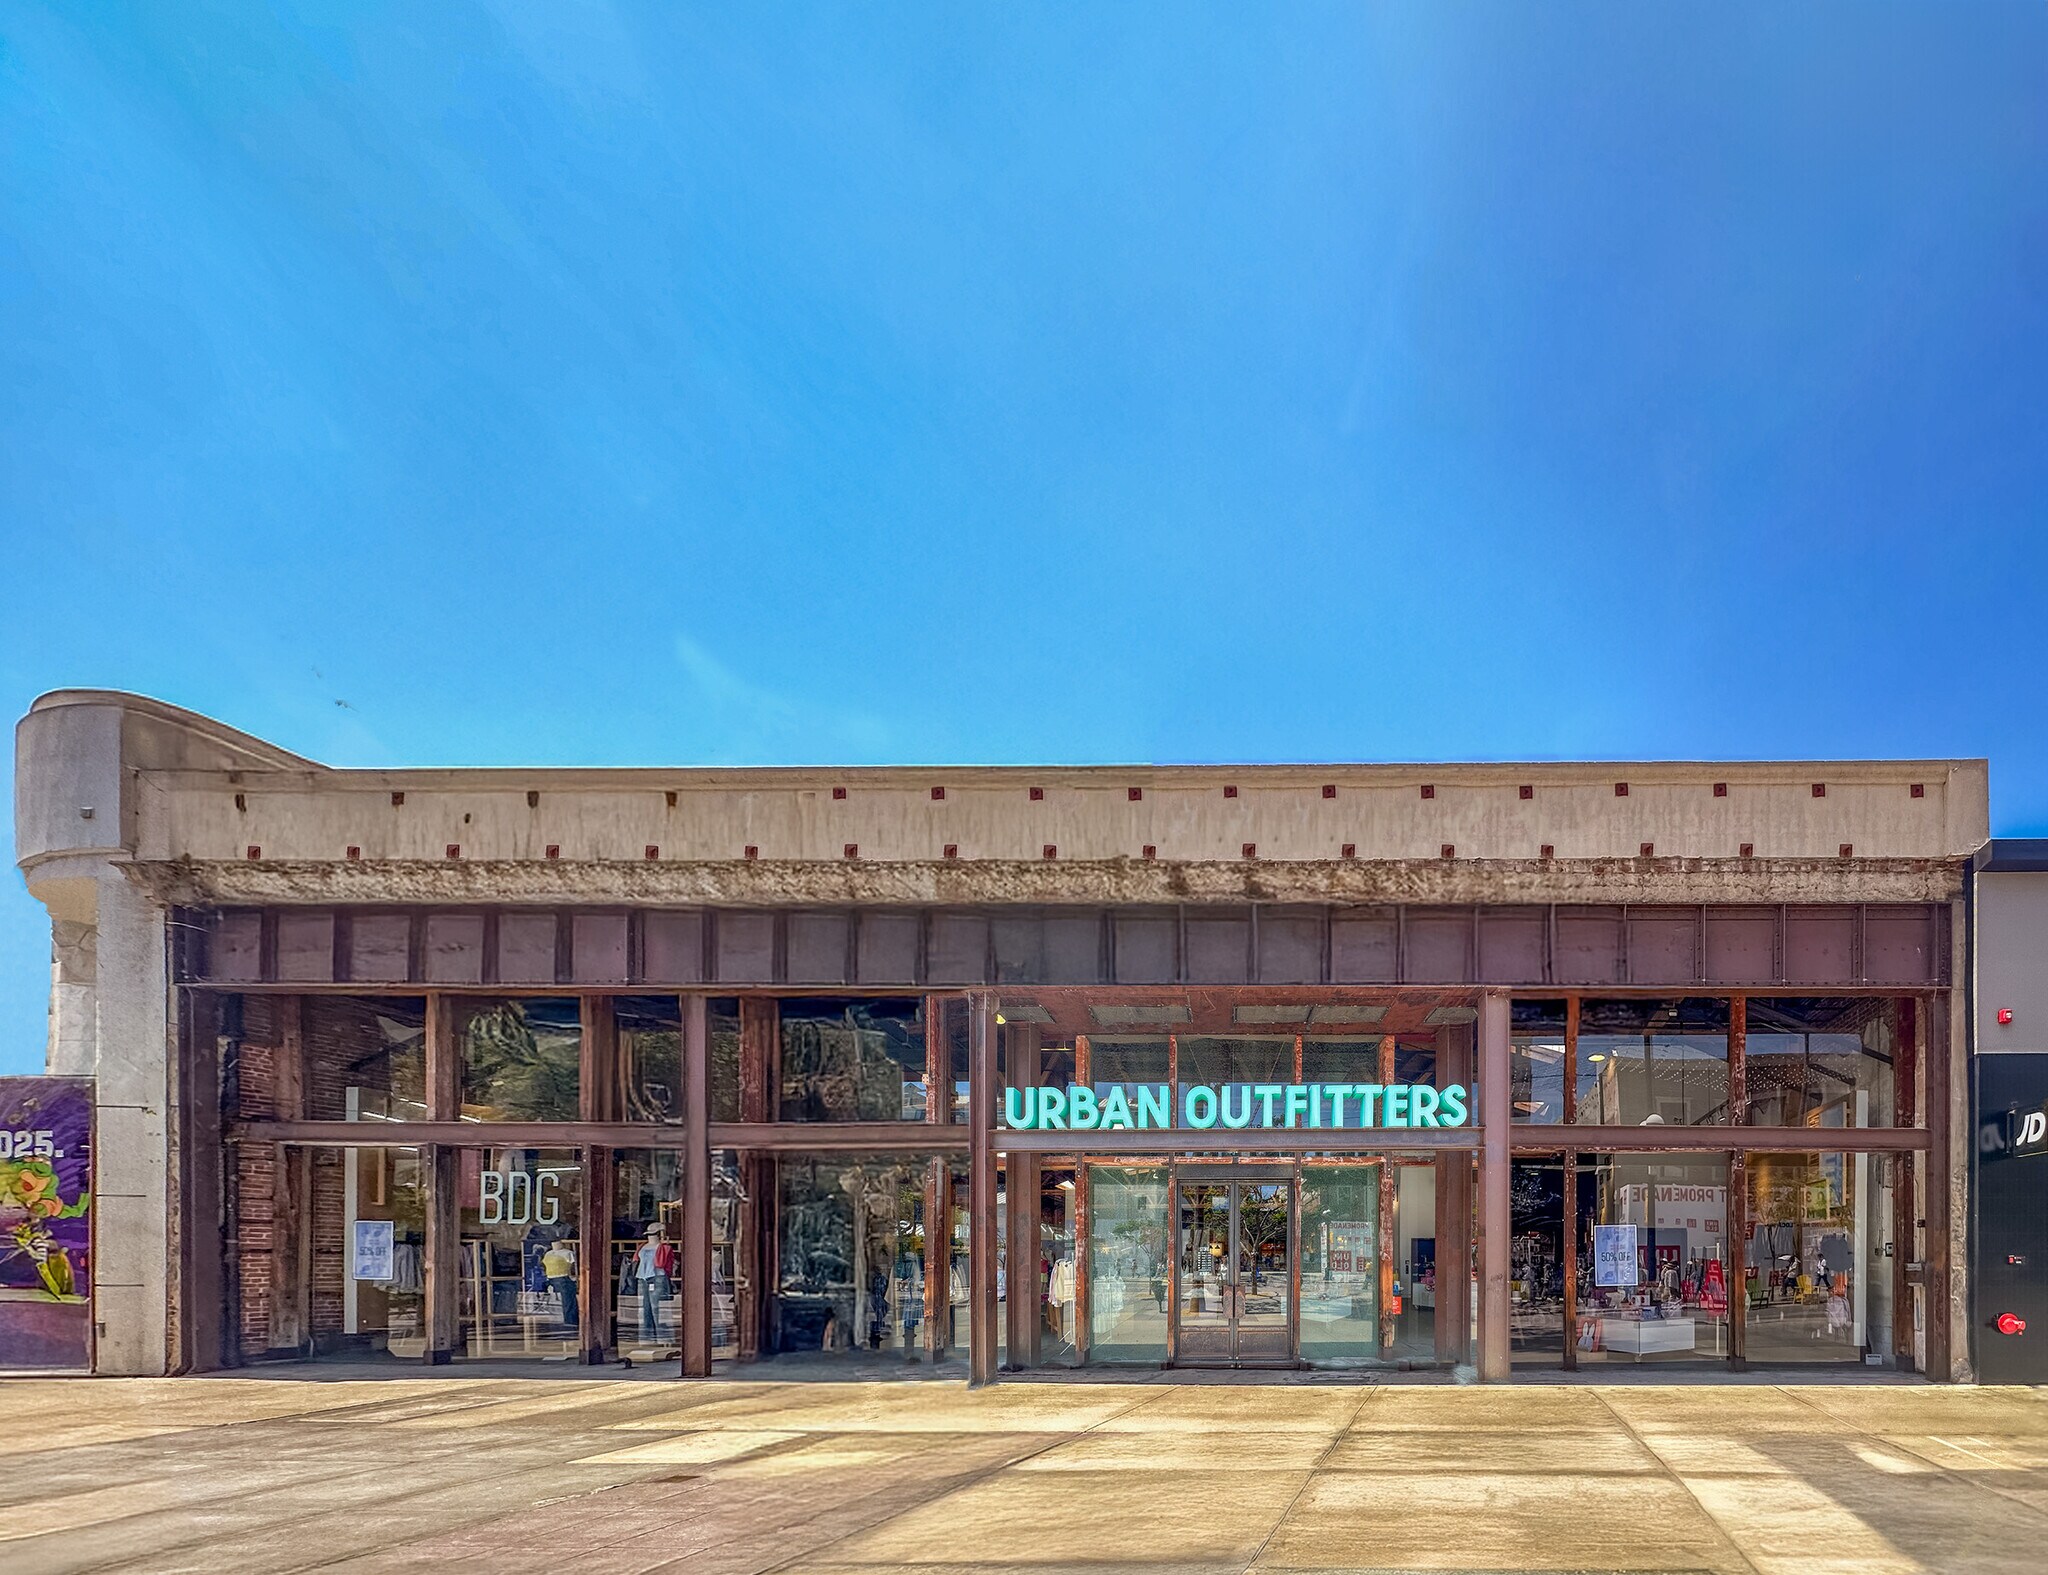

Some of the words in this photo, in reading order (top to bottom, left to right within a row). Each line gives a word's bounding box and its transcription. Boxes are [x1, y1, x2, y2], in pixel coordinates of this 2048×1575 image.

[1005, 1085, 1170, 1129] URBAN
[1185, 1084, 1468, 1128] OUTFITTERS
[2016, 1112, 2046, 1146] JD
[479, 1171, 560, 1225] BDG
[1601, 1252, 1617, 1262] 50%
